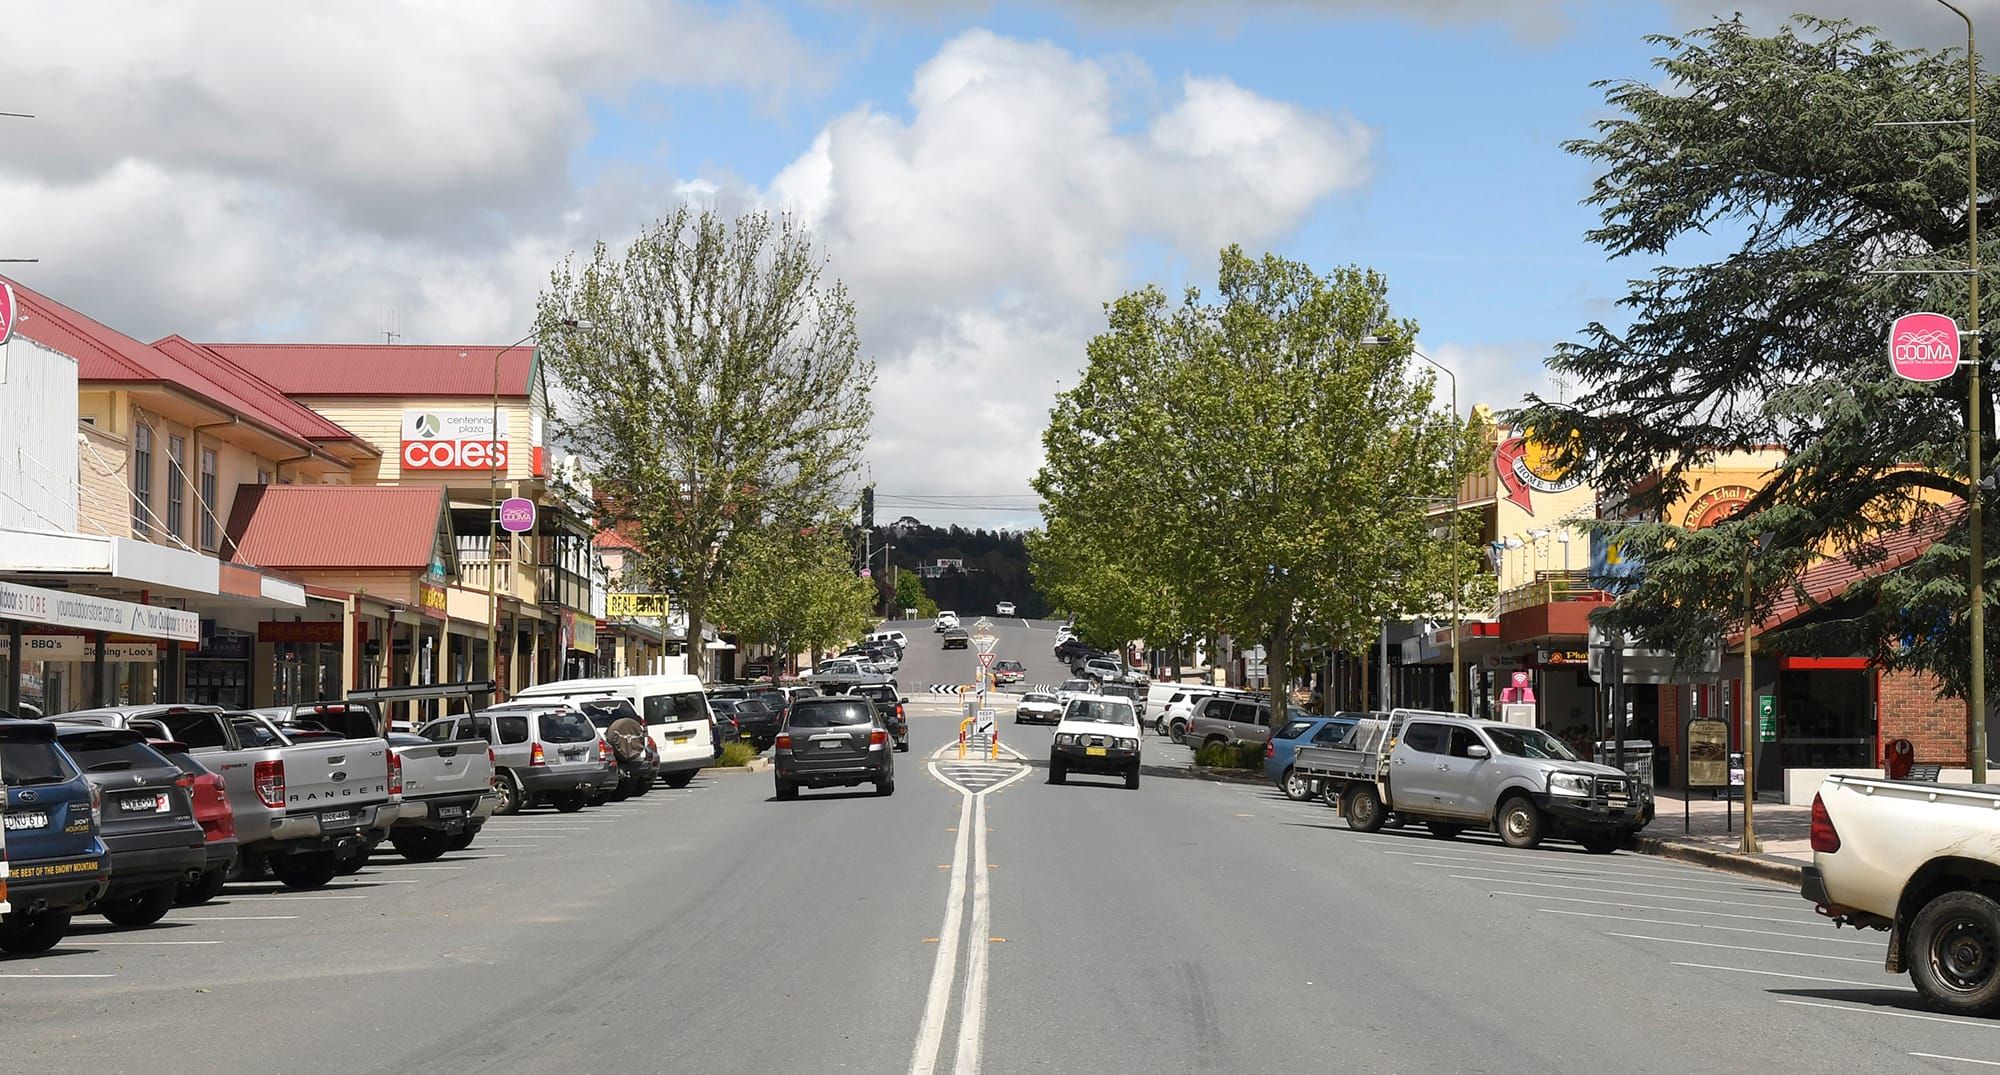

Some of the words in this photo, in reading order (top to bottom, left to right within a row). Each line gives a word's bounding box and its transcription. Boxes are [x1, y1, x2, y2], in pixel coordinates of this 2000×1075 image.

[1896, 344, 1953, 360] COOMA
[447, 416, 496, 425] centennia
[459, 424, 484, 433] plaza
[404, 440, 506, 467] coles
[1516, 464, 1544, 489] HOME
[1685, 498, 1710, 528] Pha's
[1709, 486, 1741, 501] Thai
[612, 596, 630, 612] REAL
[31, 639, 62, 649] BBQ's
[84, 647, 121, 657] Cloing
[129, 647, 153, 656] Loo's
[290, 784, 384, 802] RANGER
[9, 869, 19, 878] THE
[21, 868, 34, 877] BEST
[36, 867, 43, 876] OF
[45, 865, 54, 875] THE
[55, 864, 72, 874] SNOWY
[73, 861, 98, 872] MOUNTAINS
